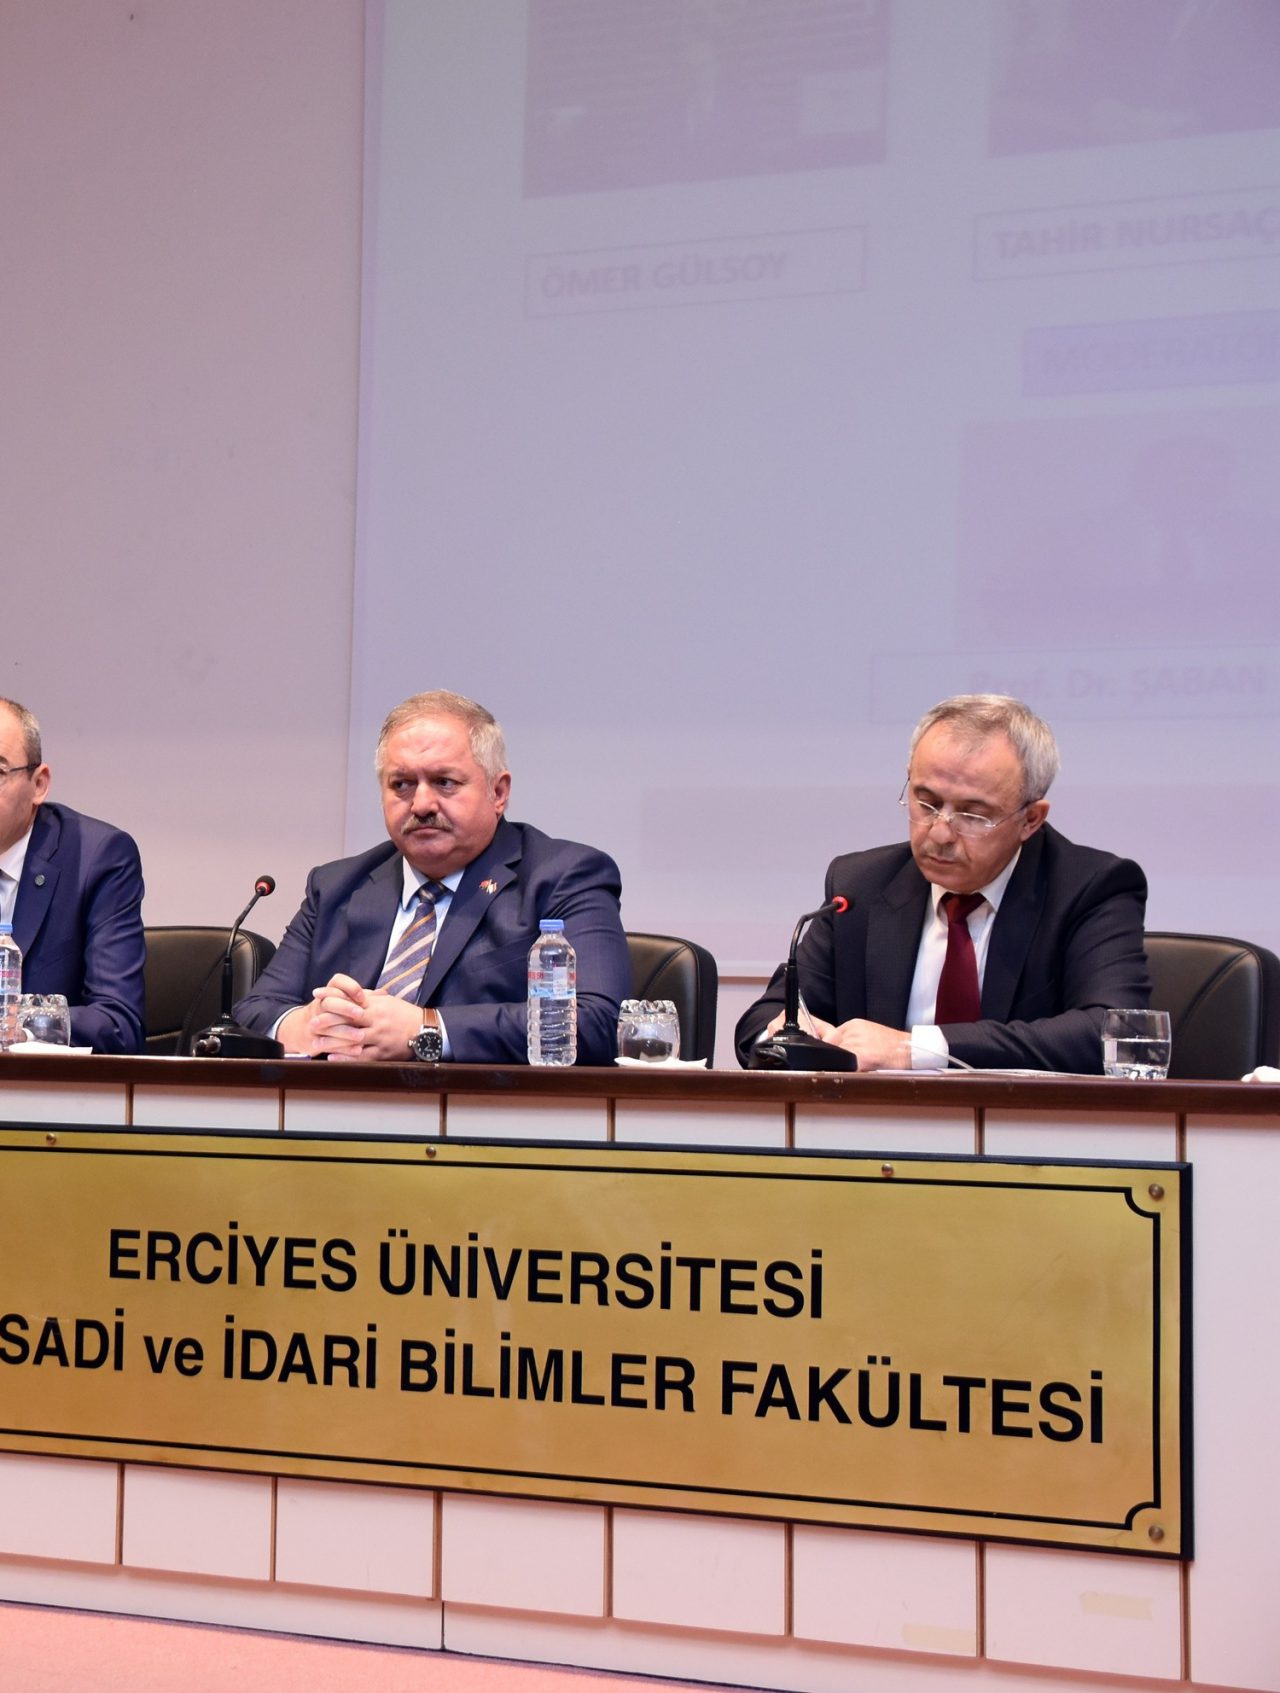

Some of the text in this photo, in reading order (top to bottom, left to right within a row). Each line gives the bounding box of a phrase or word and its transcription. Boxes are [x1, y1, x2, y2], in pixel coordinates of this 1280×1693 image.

[993, 218, 1106, 259] TAHİR
[541, 252, 788, 299] ÖMER GÜLSOY
[1068, 669, 1117, 698] Dr.
[1131, 664, 1268, 702] ŞABAN
[109, 1221, 823, 1319] ERCİYES ÜNİVERSİTESİ
[143, 1335, 204, 1377] ve
[223, 1314, 377, 1389] İDARİ
[400, 1327, 695, 1413] BİLİMLER
[721, 1355, 1103, 1444] FAKÜLTESİ
